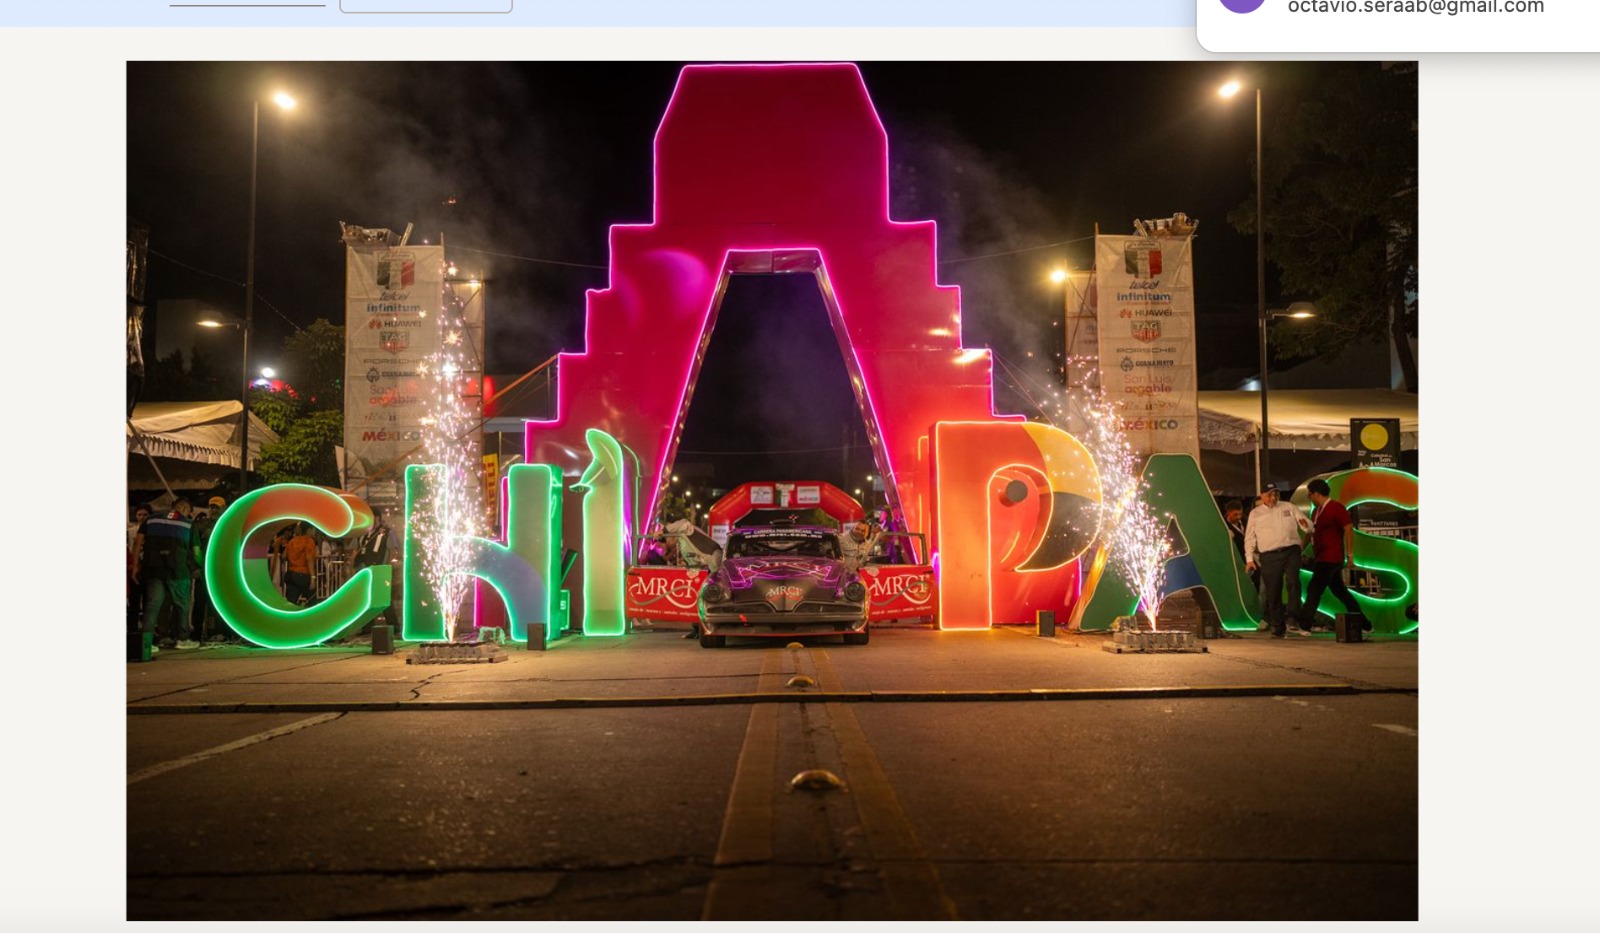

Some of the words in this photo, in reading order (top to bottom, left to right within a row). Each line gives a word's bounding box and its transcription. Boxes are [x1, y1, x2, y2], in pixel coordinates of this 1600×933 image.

[1117, 292, 1171, 301] infinitum
[367, 303, 420, 312] infinitum
[1135, 309, 1172, 317] HUAWEI
[384, 320, 422, 328] HUAWEI
[1135, 322, 1158, 330] TAG
[383, 333, 407, 341] TAG
[1124, 374, 1146, 384] San
